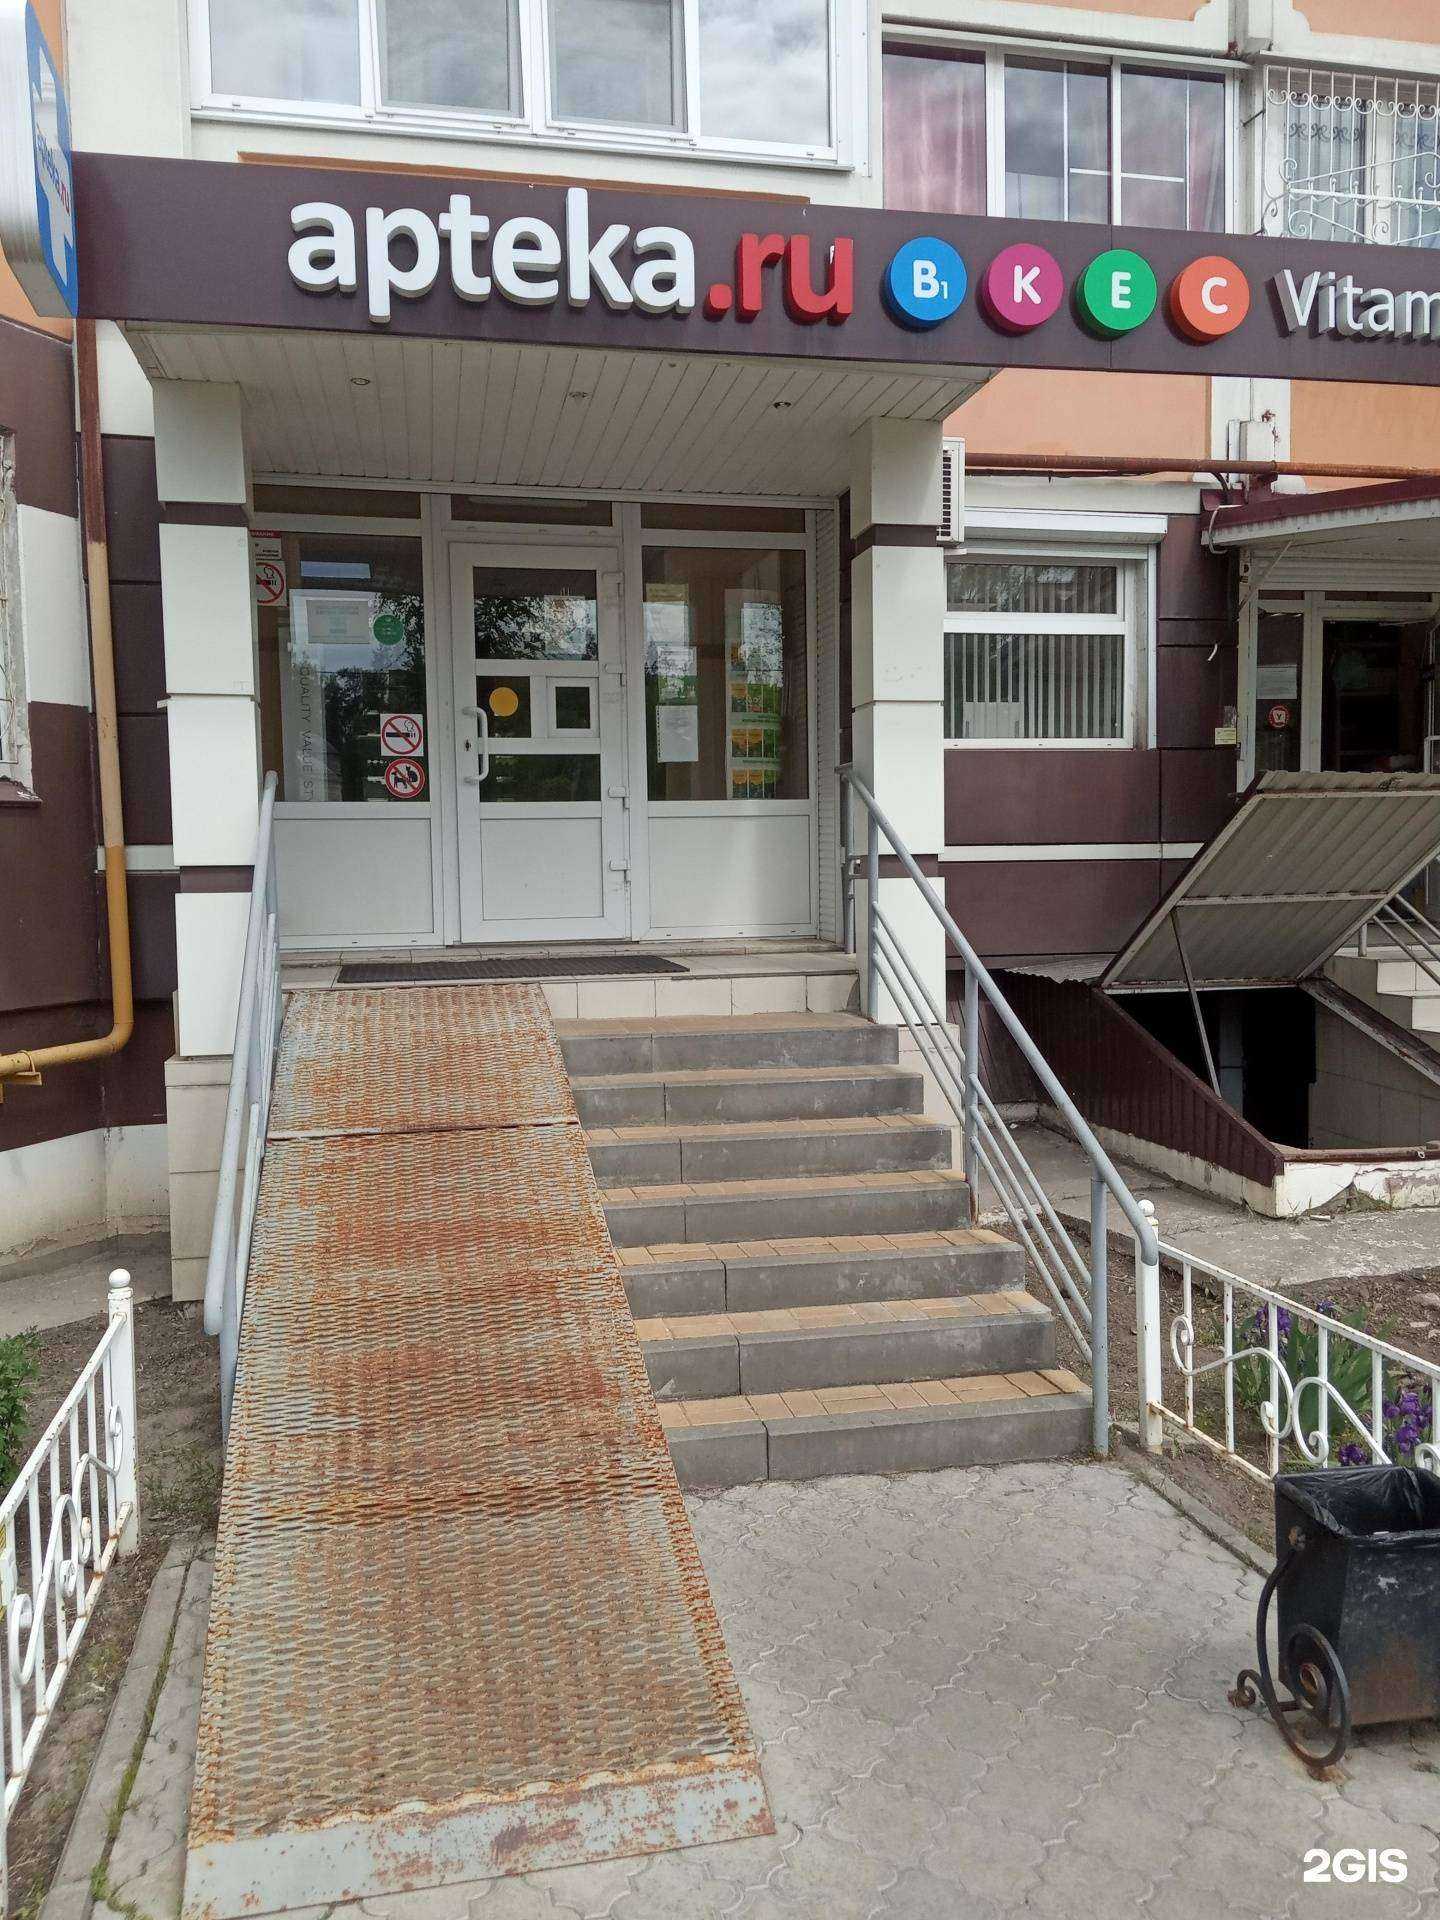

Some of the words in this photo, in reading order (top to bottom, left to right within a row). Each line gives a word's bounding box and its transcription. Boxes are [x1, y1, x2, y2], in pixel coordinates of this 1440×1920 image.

[287, 187, 854, 325] apteka.ru
[1012, 264, 1042, 305] K
[1110, 270, 1132, 309] E
[1201, 276, 1228, 314] C
